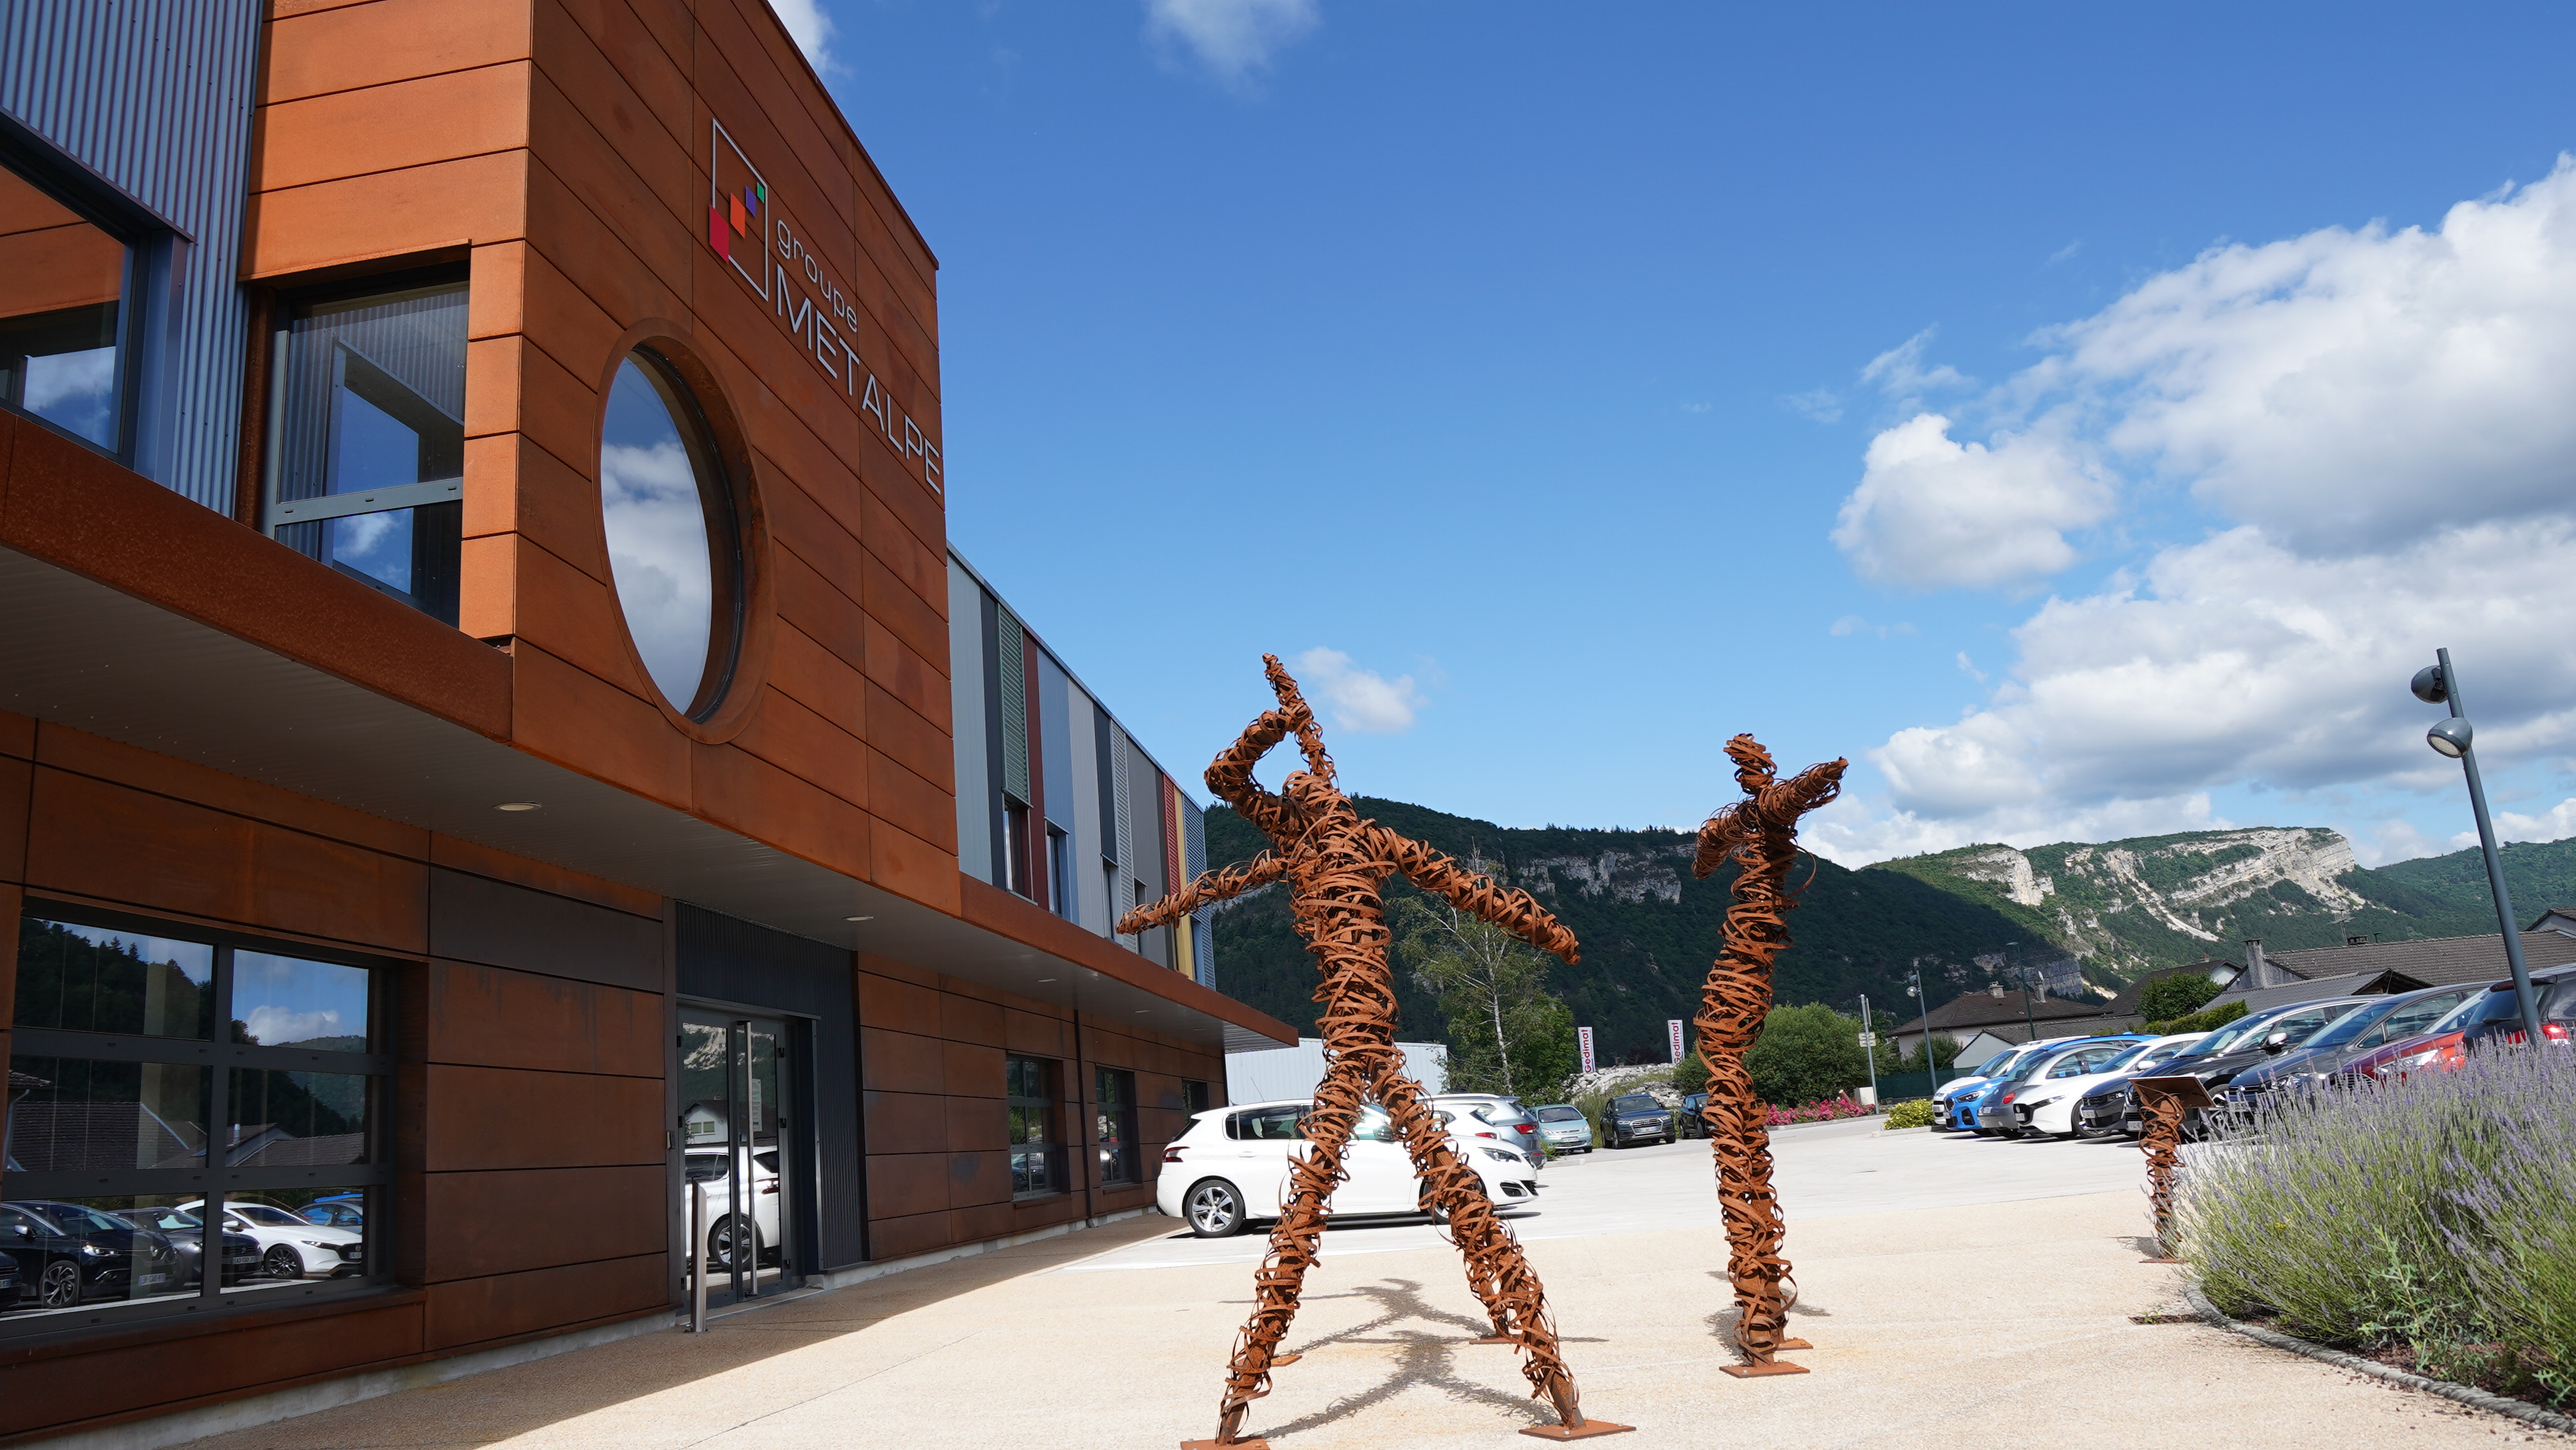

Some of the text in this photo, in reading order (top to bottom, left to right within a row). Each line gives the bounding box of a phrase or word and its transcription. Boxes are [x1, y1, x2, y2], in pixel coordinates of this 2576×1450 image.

[777, 219, 857, 333] groupe
[777, 264, 941, 495] METALPE
[1581, 1029, 1592, 1072] Gedimat
